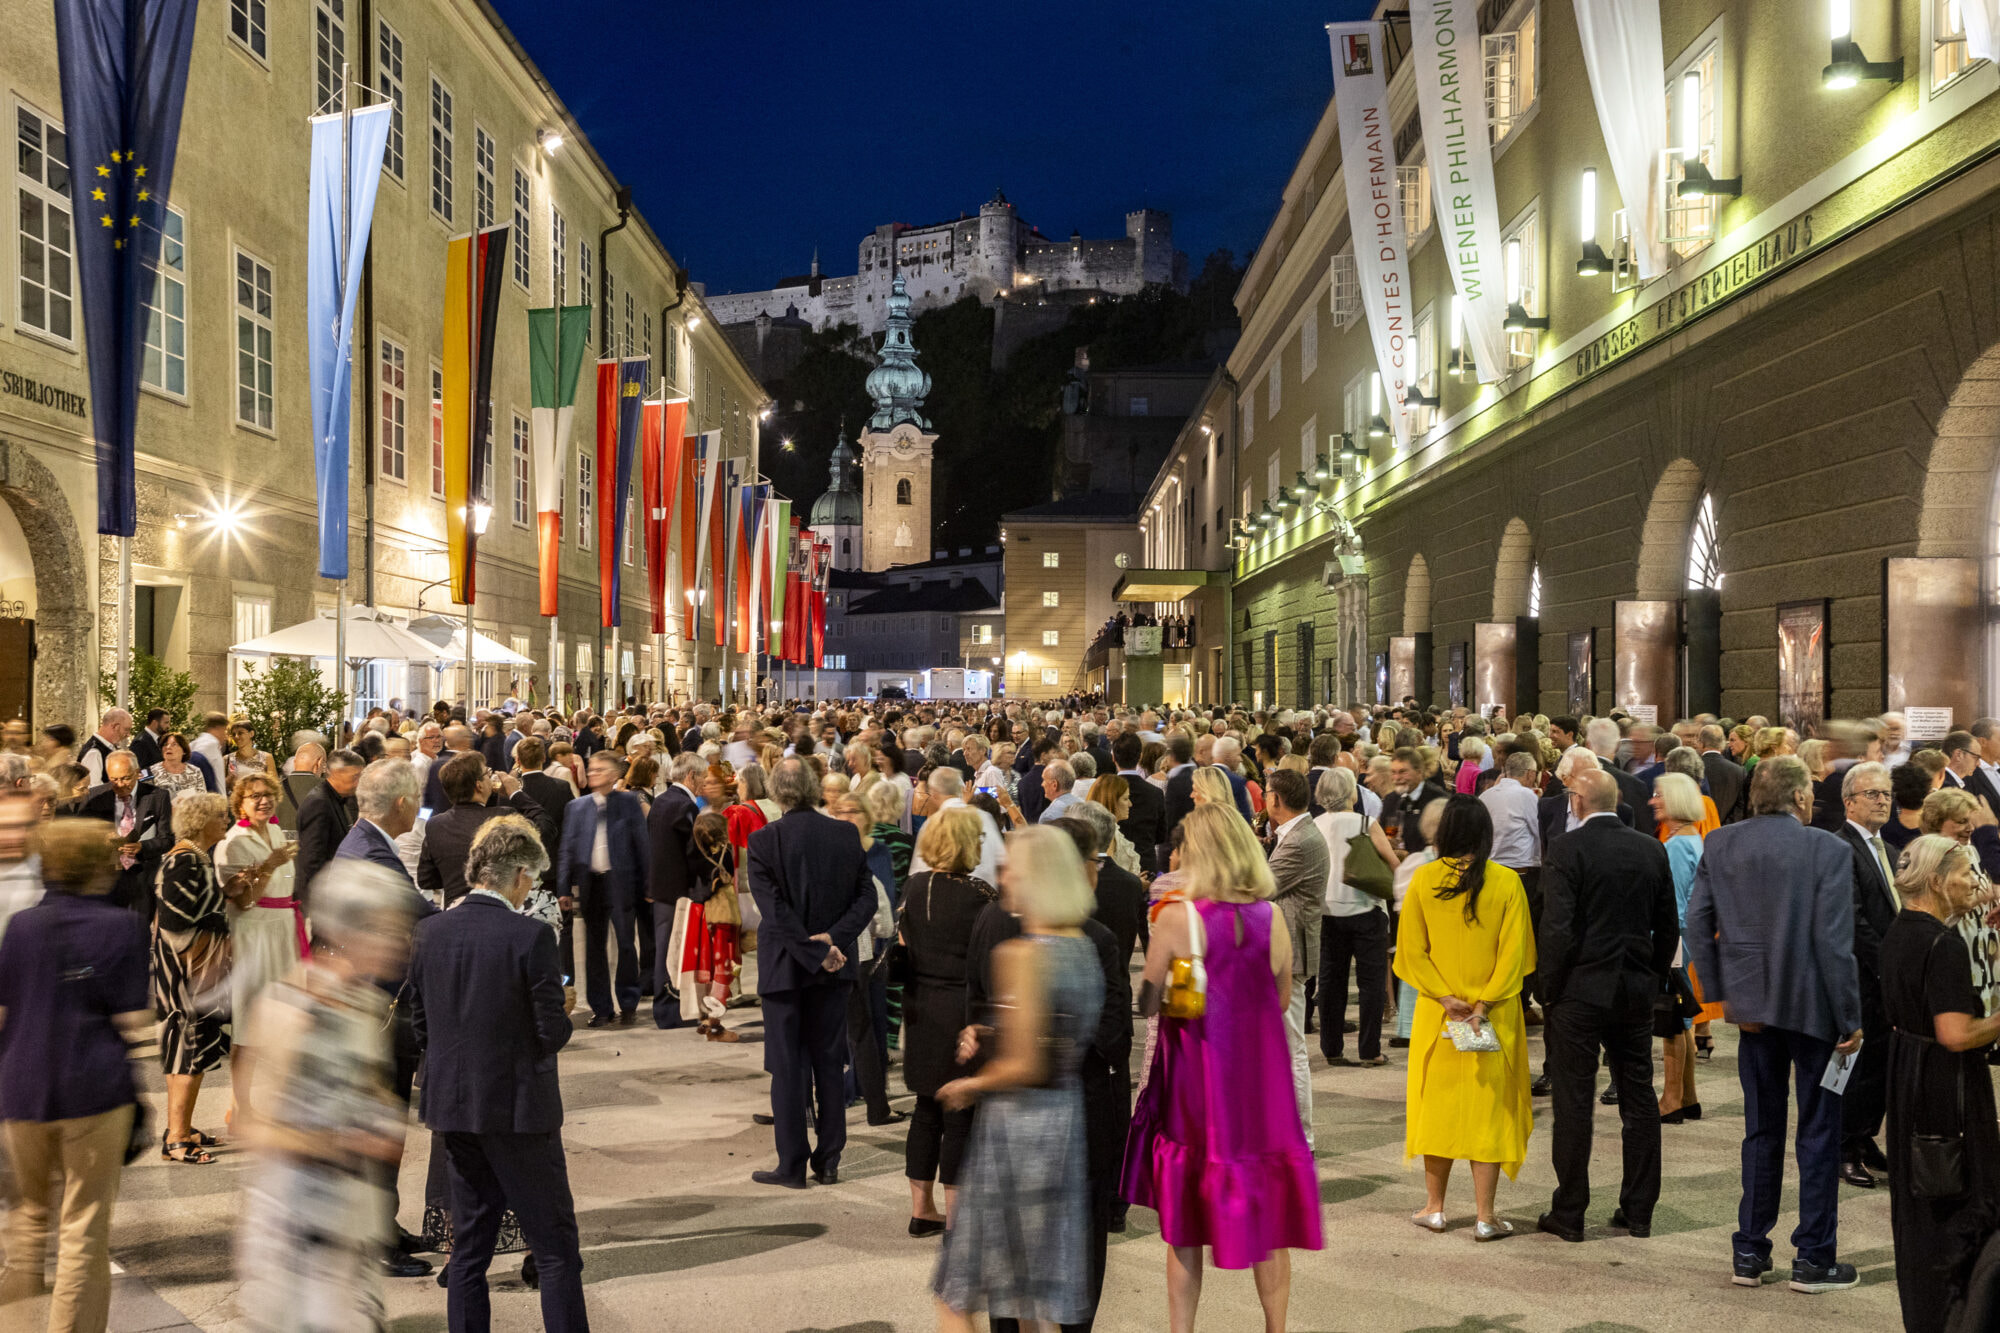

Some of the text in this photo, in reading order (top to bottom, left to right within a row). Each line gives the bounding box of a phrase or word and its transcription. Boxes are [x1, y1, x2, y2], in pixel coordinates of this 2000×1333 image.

[1363, 107, 1396, 261] D'HOFFMANN
[1453, 194, 1482, 301] WIENER
[1382, 272, 1404, 368] CONTES
[1577, 214, 1813, 376] GROSSES FESTSPIELHAUS
